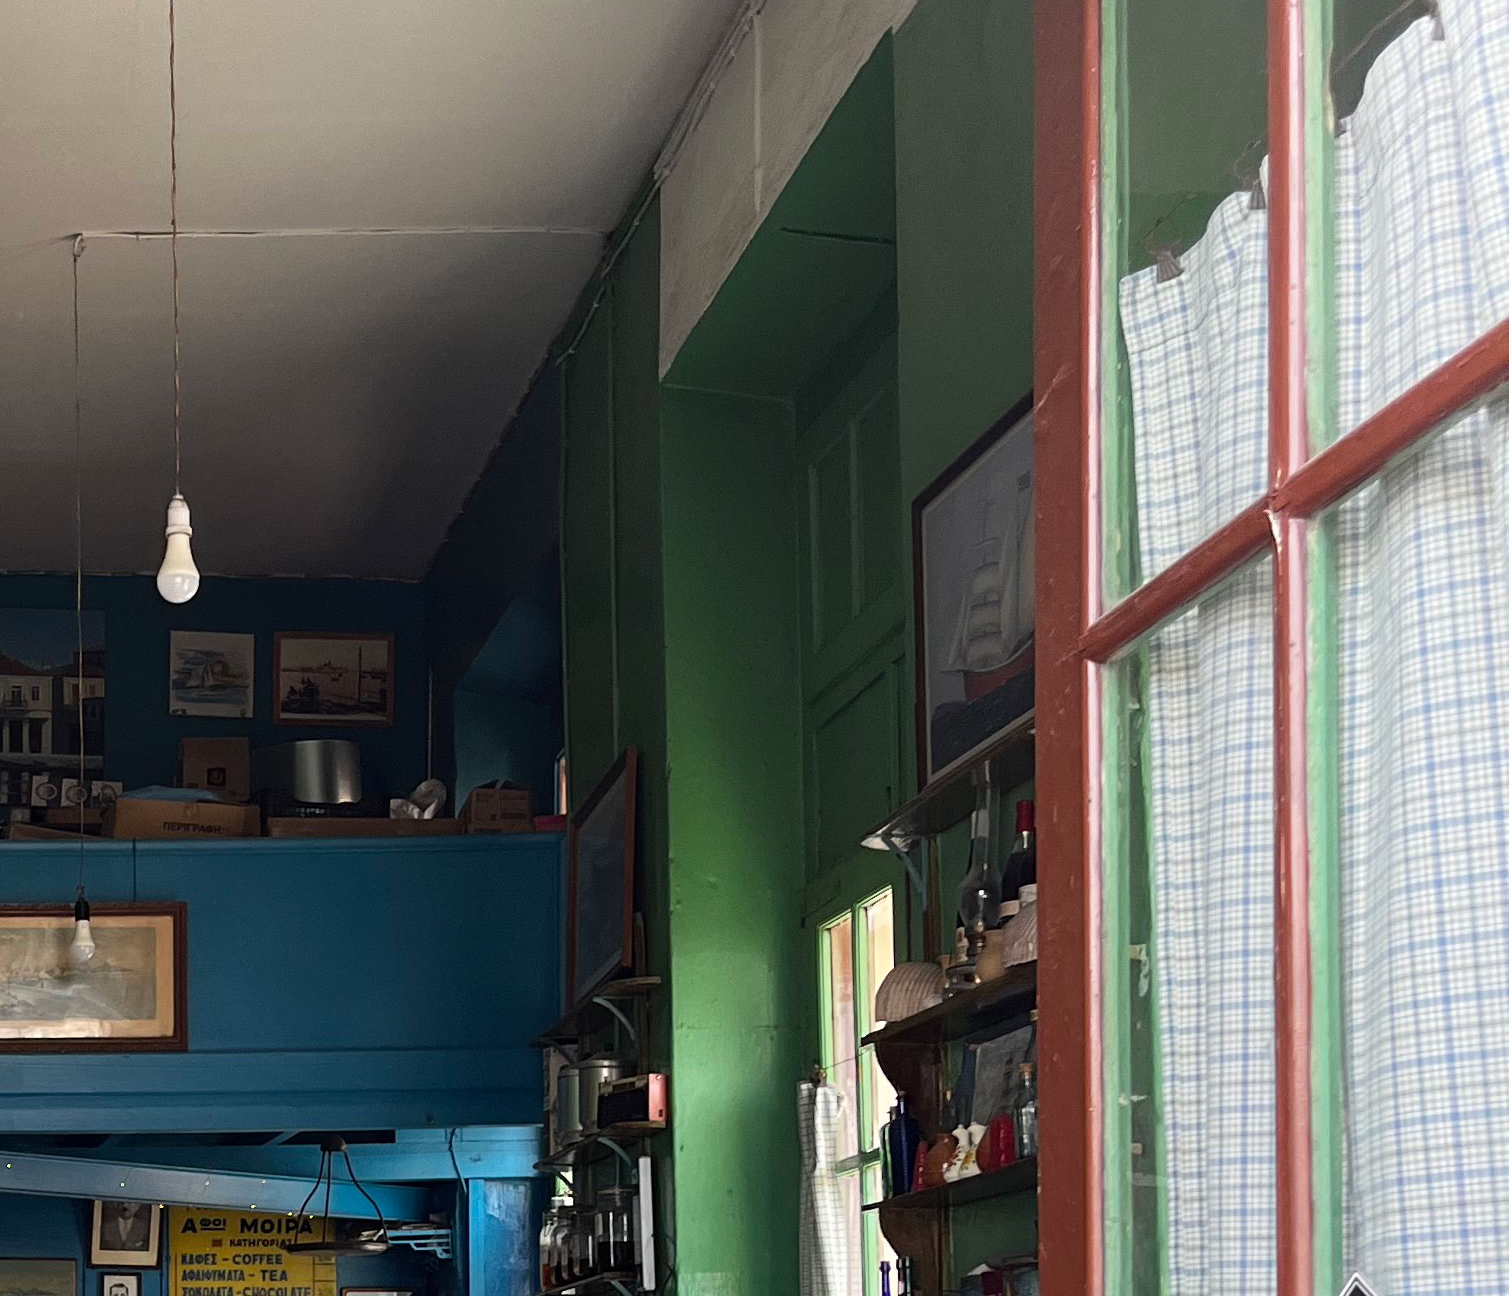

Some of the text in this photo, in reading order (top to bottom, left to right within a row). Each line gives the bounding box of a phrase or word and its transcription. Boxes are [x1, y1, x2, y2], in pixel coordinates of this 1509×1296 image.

[240, 1217, 313, 1234] ΜΟΙΡΑ
[232, 1253, 283, 1266] COFFEE
[260, 1269, 288, 1282] TEA
